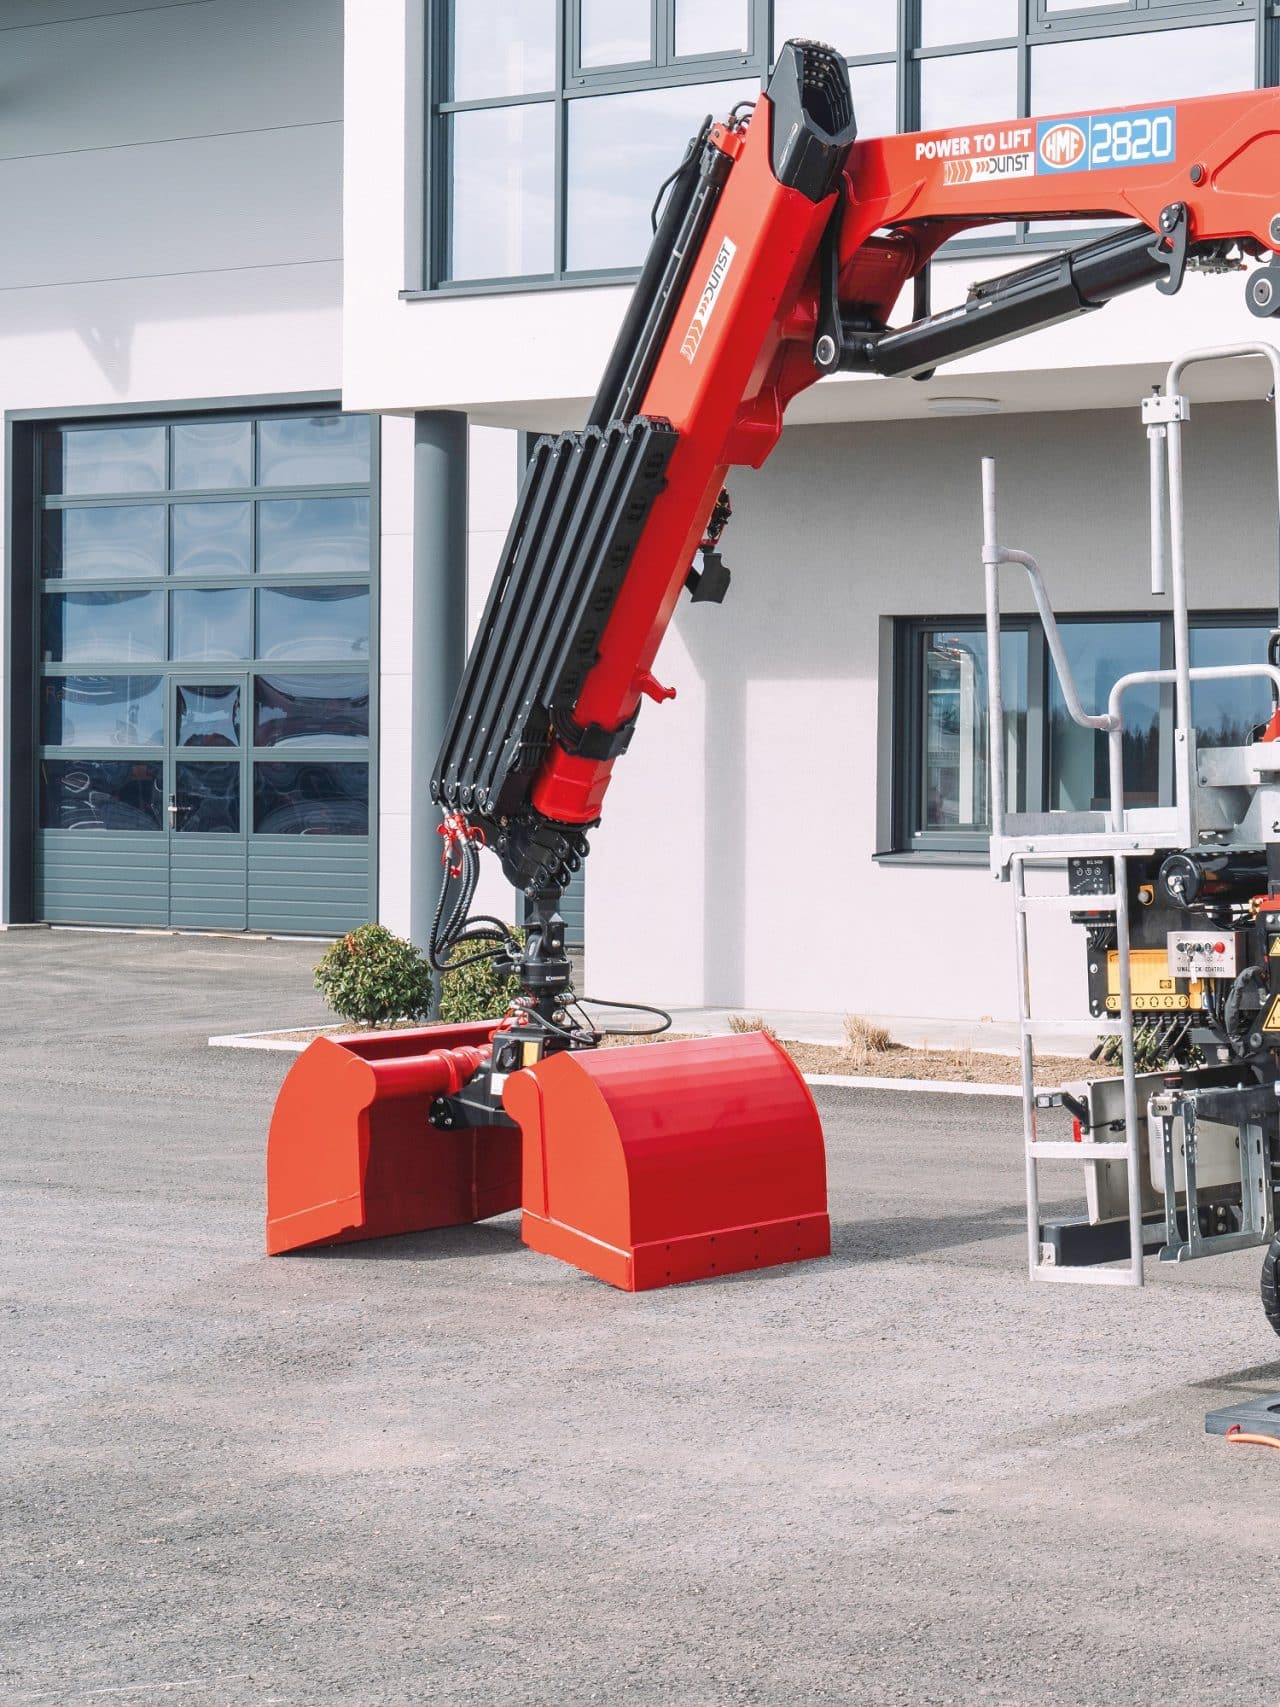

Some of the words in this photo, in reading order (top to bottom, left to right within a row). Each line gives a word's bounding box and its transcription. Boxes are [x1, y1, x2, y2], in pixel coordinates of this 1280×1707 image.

[915, 136, 970, 160] POWER
[974, 133, 995, 153] TO
[999, 128, 1032, 150] LIFT
[1045, 129, 1080, 163] HMF
[1091, 116, 1172, 164] 2820
[989, 154, 1030, 174] DUNST
[704, 243, 731, 301] DUNST
